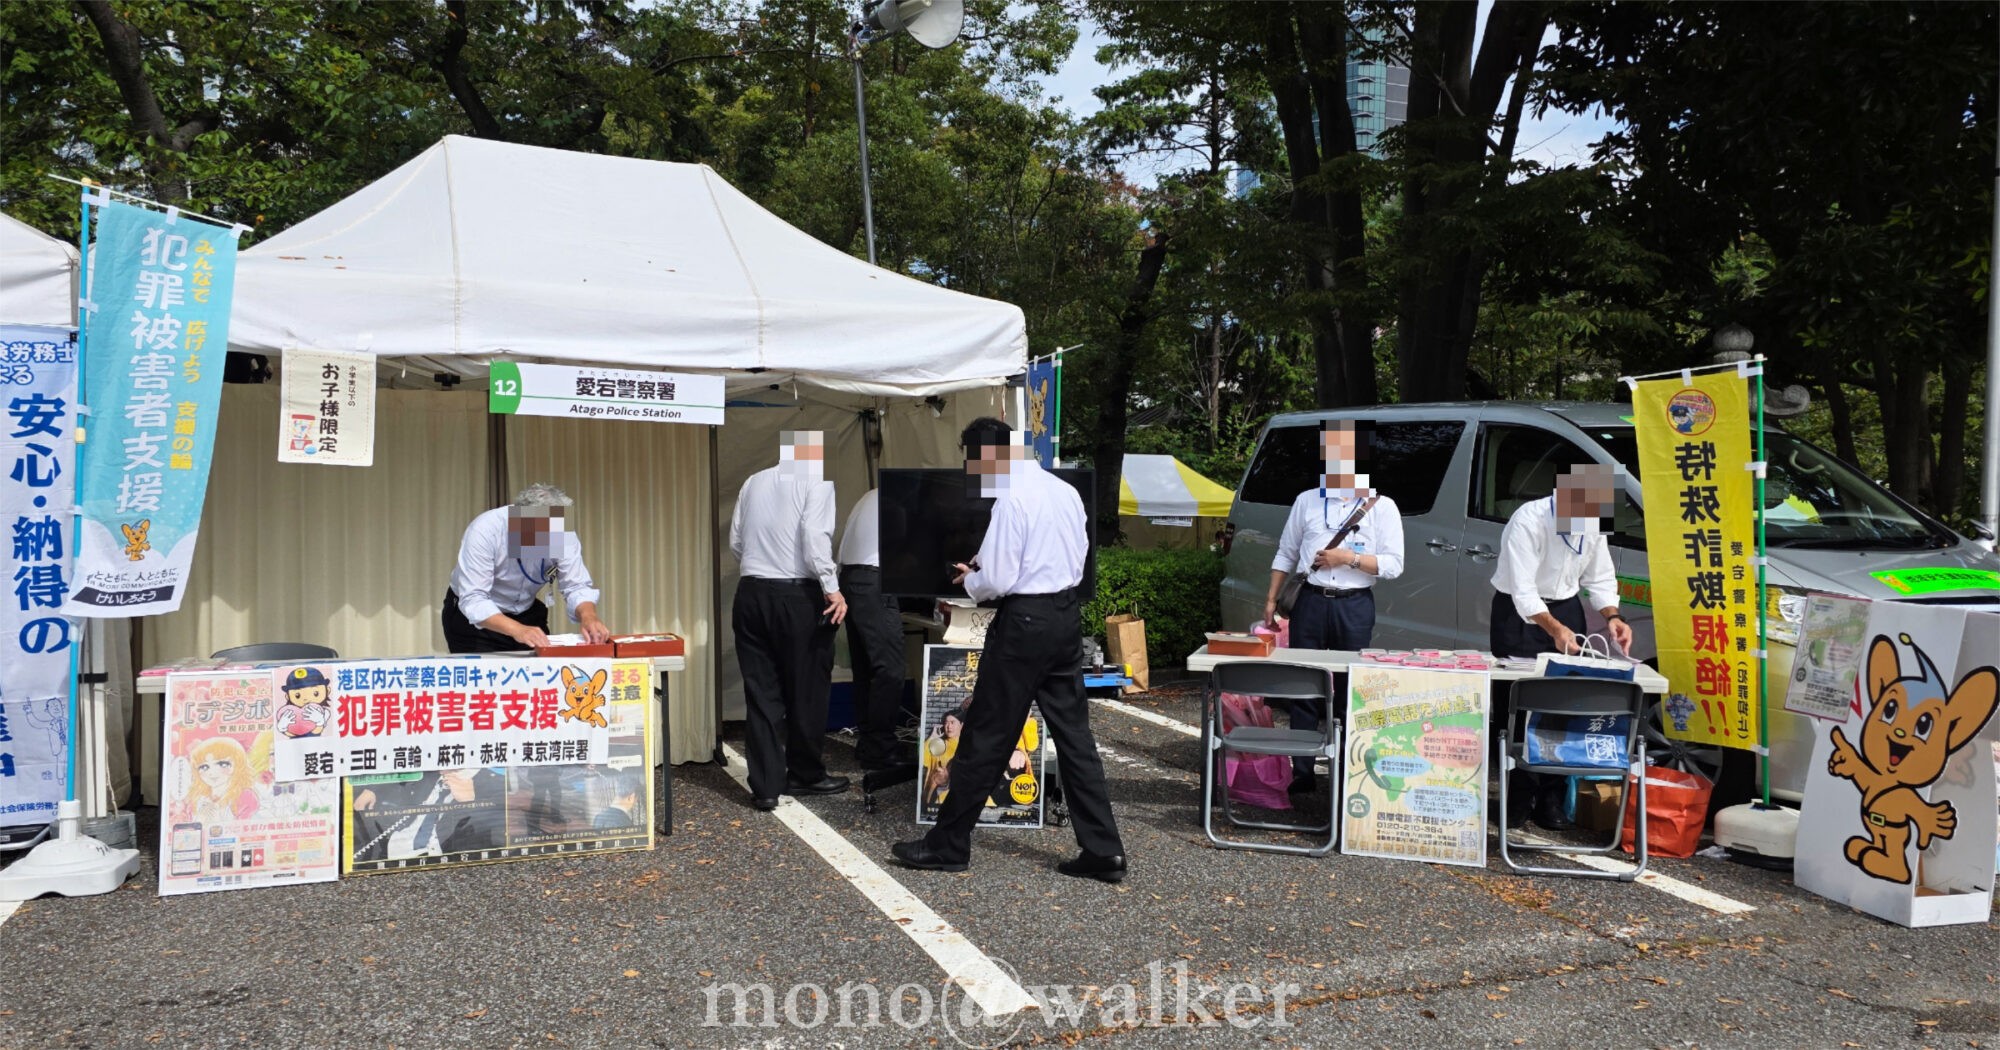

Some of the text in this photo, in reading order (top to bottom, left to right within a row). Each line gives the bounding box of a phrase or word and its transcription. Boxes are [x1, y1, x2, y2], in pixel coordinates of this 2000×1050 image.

[116, 227, 188, 514] 犯罪被害者支援
[170, 239, 215, 470] みんなで 広げよう 支援の輪
[318, 363, 340, 454] お子様限定
[495, 381, 517, 396] 12
[570, 404, 681, 418] Atago Police Station
[576, 377, 676, 400] 愛宕警察署
[8, 393, 71, 654] 安心・納得の
[337, 662, 560, 690] 港区内六警察合同キャンペーン
[337, 687, 560, 738] 犯罪被害者支援
